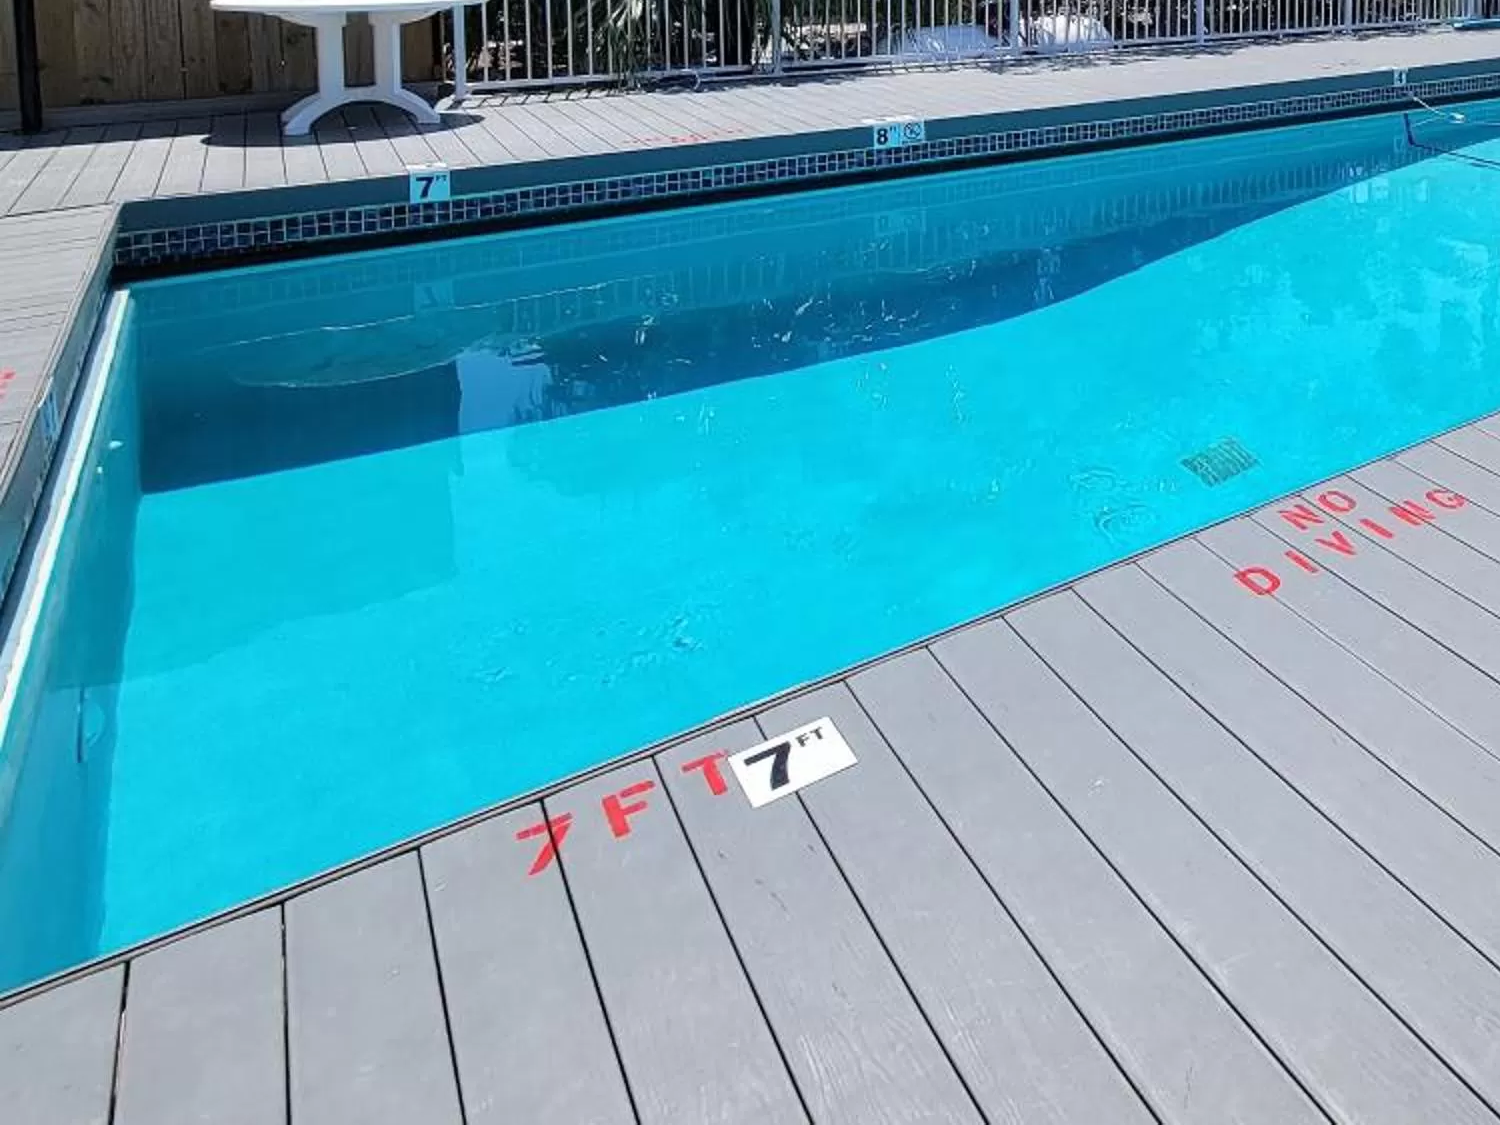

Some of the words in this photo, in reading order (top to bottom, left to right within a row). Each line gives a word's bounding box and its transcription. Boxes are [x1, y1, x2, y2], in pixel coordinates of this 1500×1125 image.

[876, 127, 889, 146] 8
[415, 176, 434, 199] 7
[1279, 490, 1356, 531] NO
[1234, 489, 1466, 596] DIVING
[744, 741, 792, 791] 7
[797, 726, 825, 748] FT
